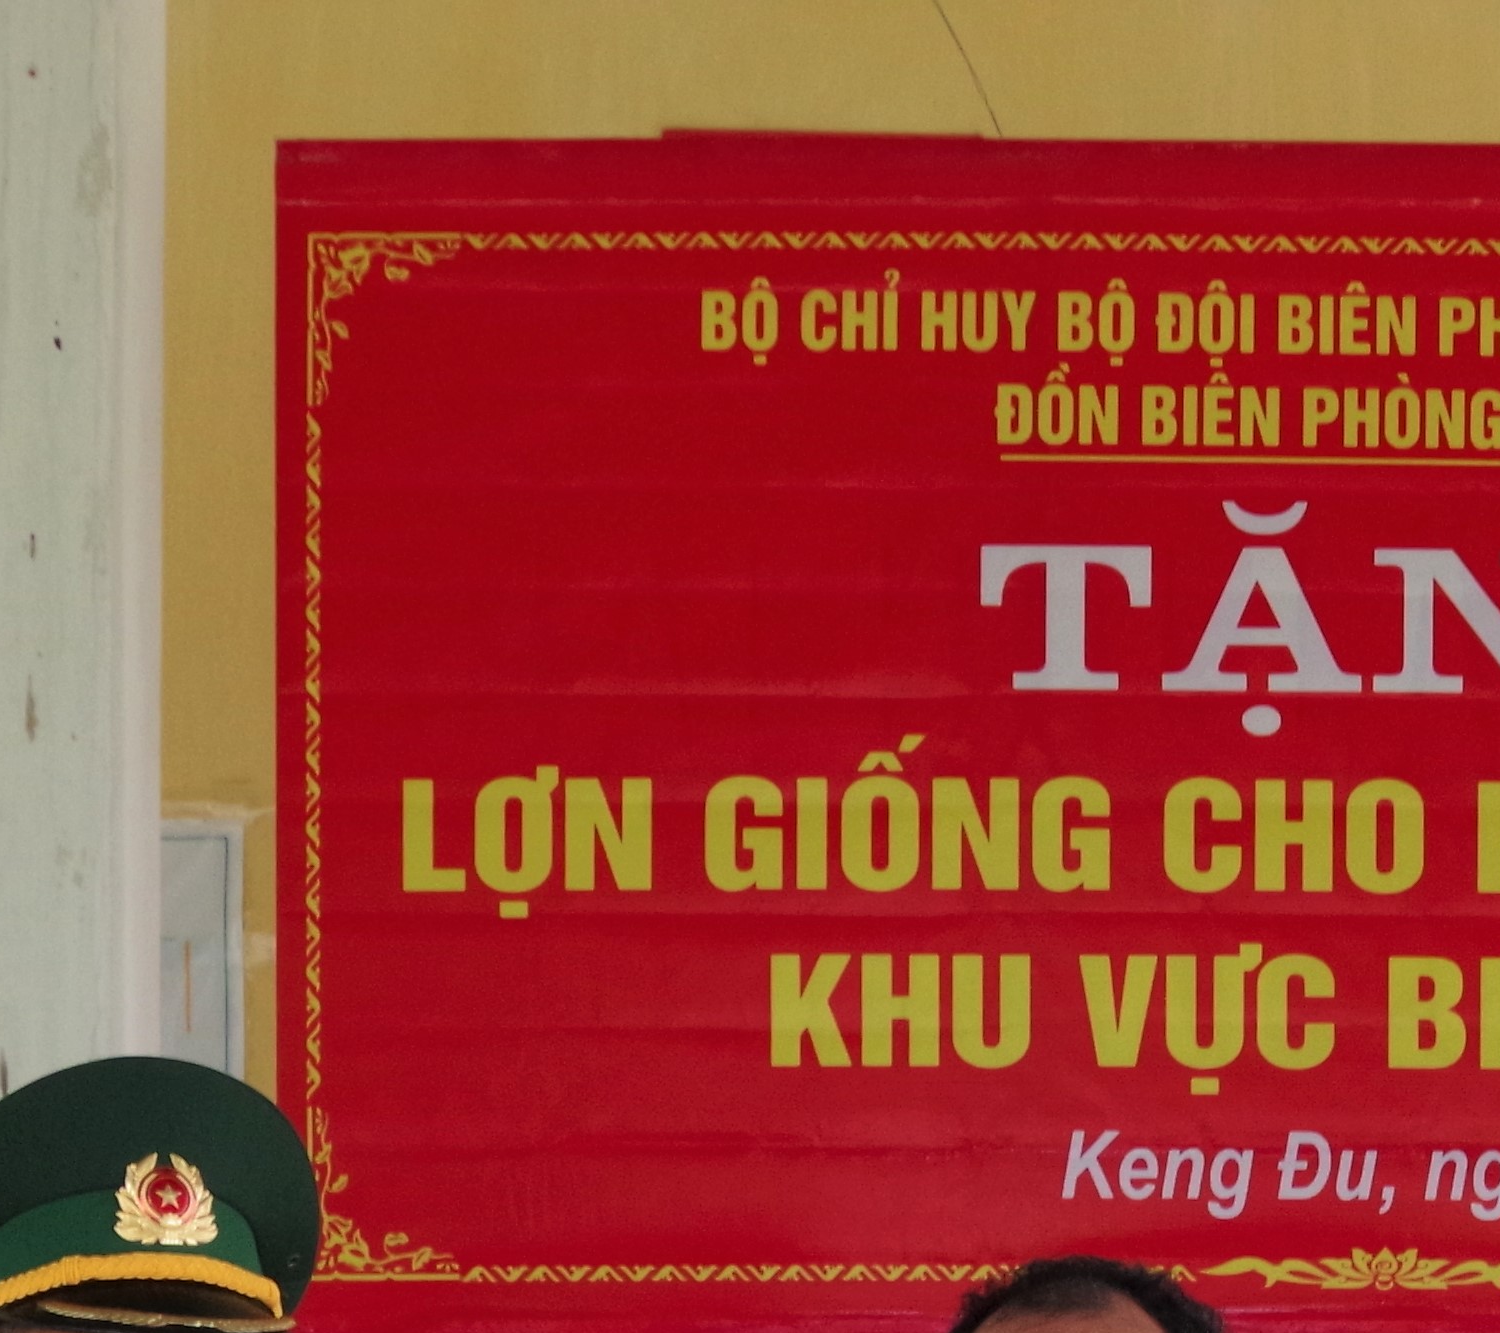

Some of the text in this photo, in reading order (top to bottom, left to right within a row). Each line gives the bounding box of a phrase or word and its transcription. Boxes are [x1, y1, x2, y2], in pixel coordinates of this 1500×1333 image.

[702, 278, 777, 364] BỘ
[801, 270, 900, 351] CHỈ
[922, 292, 1035, 351] HUY
[1058, 279, 1134, 372] BỘ
[1156, 280, 1254, 366] ĐỘI
[1279, 282, 1416, 355] BIÊN
[995, 362, 1118, 444] ĐỒN
[1142, 373, 1279, 446] BIÊN
[403, 766, 652, 918] LỢN
[705, 735, 1110, 892] GIỐNG
[1164, 777, 1424, 894] CHO
[771, 954, 1031, 1068] KHU
[1079, 943, 1335, 1095] VỰC
[1062, 1130, 1253, 1219] Keng
[1278, 1131, 1394, 1214] Đu,
